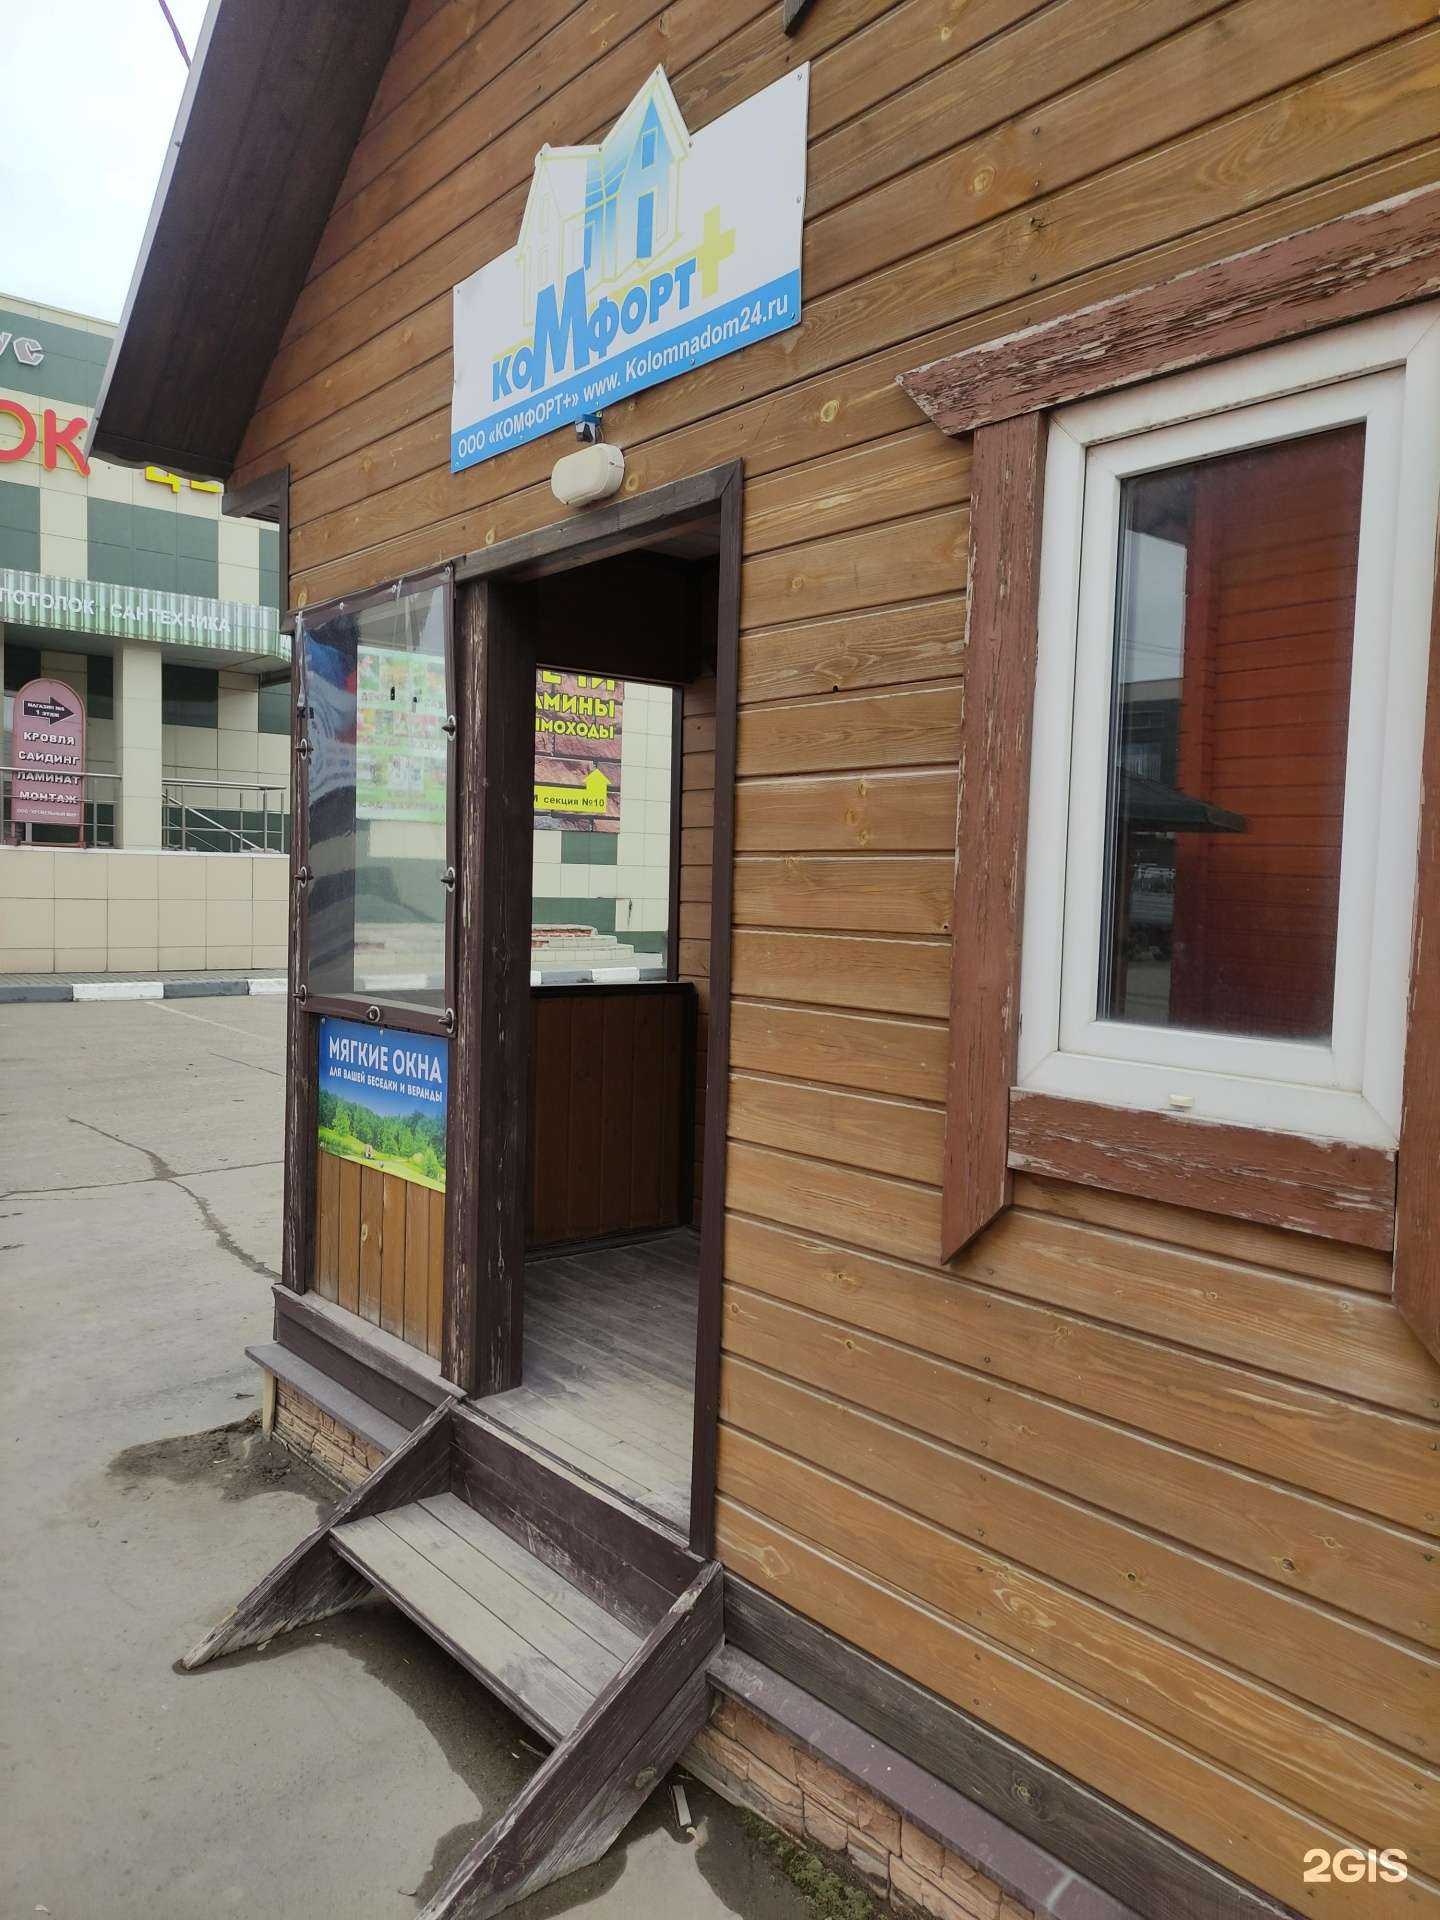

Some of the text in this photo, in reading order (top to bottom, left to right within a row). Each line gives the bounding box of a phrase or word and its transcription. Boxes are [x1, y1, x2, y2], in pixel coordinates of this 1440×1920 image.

[458, 294, 788, 459] ООО «КОМФОРТ+» www. Kolomnadom24.ru
[111, 603, 231, 633] САНТЕХНИКА
[536, 691, 615, 718] АМИНЫ
[23, 731, 75, 746] КРОВЛЯ
[18, 750, 80, 765] САЙДИНГ
[16, 770, 80, 786] ЛАМИНАТ
[19, 790, 78, 804] МОНТАЖ
[543, 796, 579, 807] секция
[329, 1036, 443, 1083] МЯГКИЕ ОКНА
[329, 1066, 443, 1103] ДЛЯ ВАШЕЙ БЕСЕДКИ И ВЕРАНДЫ
